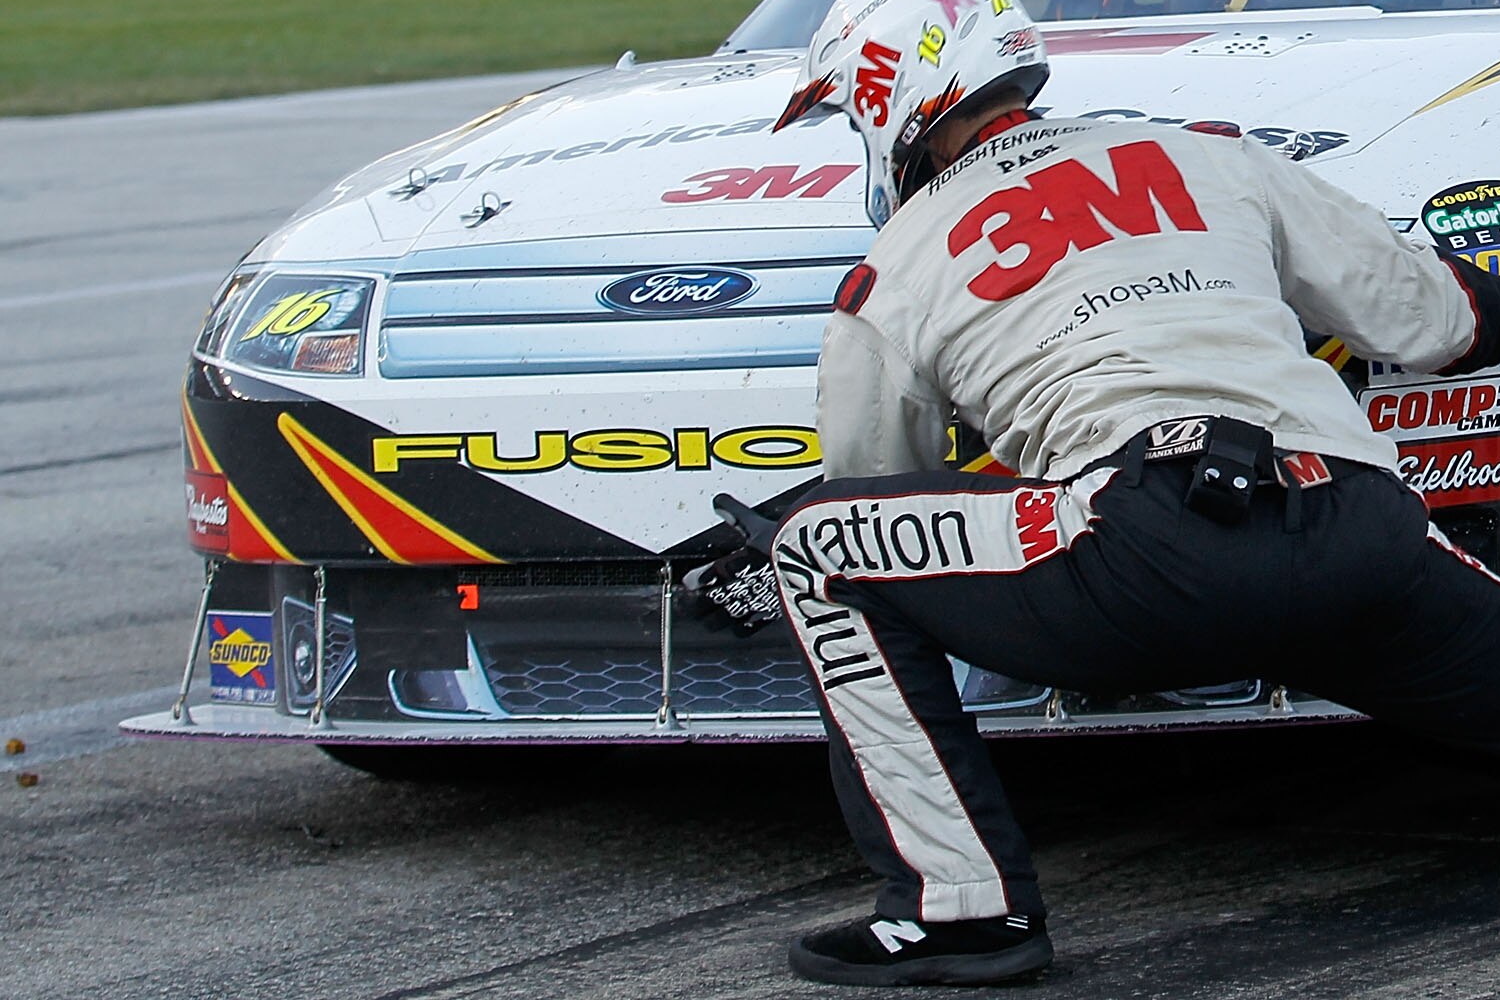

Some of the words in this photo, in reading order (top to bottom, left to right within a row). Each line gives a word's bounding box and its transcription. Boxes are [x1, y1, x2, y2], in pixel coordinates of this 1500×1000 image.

[917, 18, 947, 69] 16
[854, 36, 903, 128] 3M
[661, 163, 863, 204] 3M
[947, 140, 1208, 302] 3M
[629, 273, 732, 304] Ford
[1036, 268, 1237, 351] www.shop3M.com
[239, 288, 349, 343] 16
[1367, 384, 1497, 433] COMP
[374, 426, 822, 472] FUSIO
[1174, 438, 1205, 454] WEAR
[1014, 489, 1064, 561] 3M
[211, 643, 270, 664] SUNOCO
